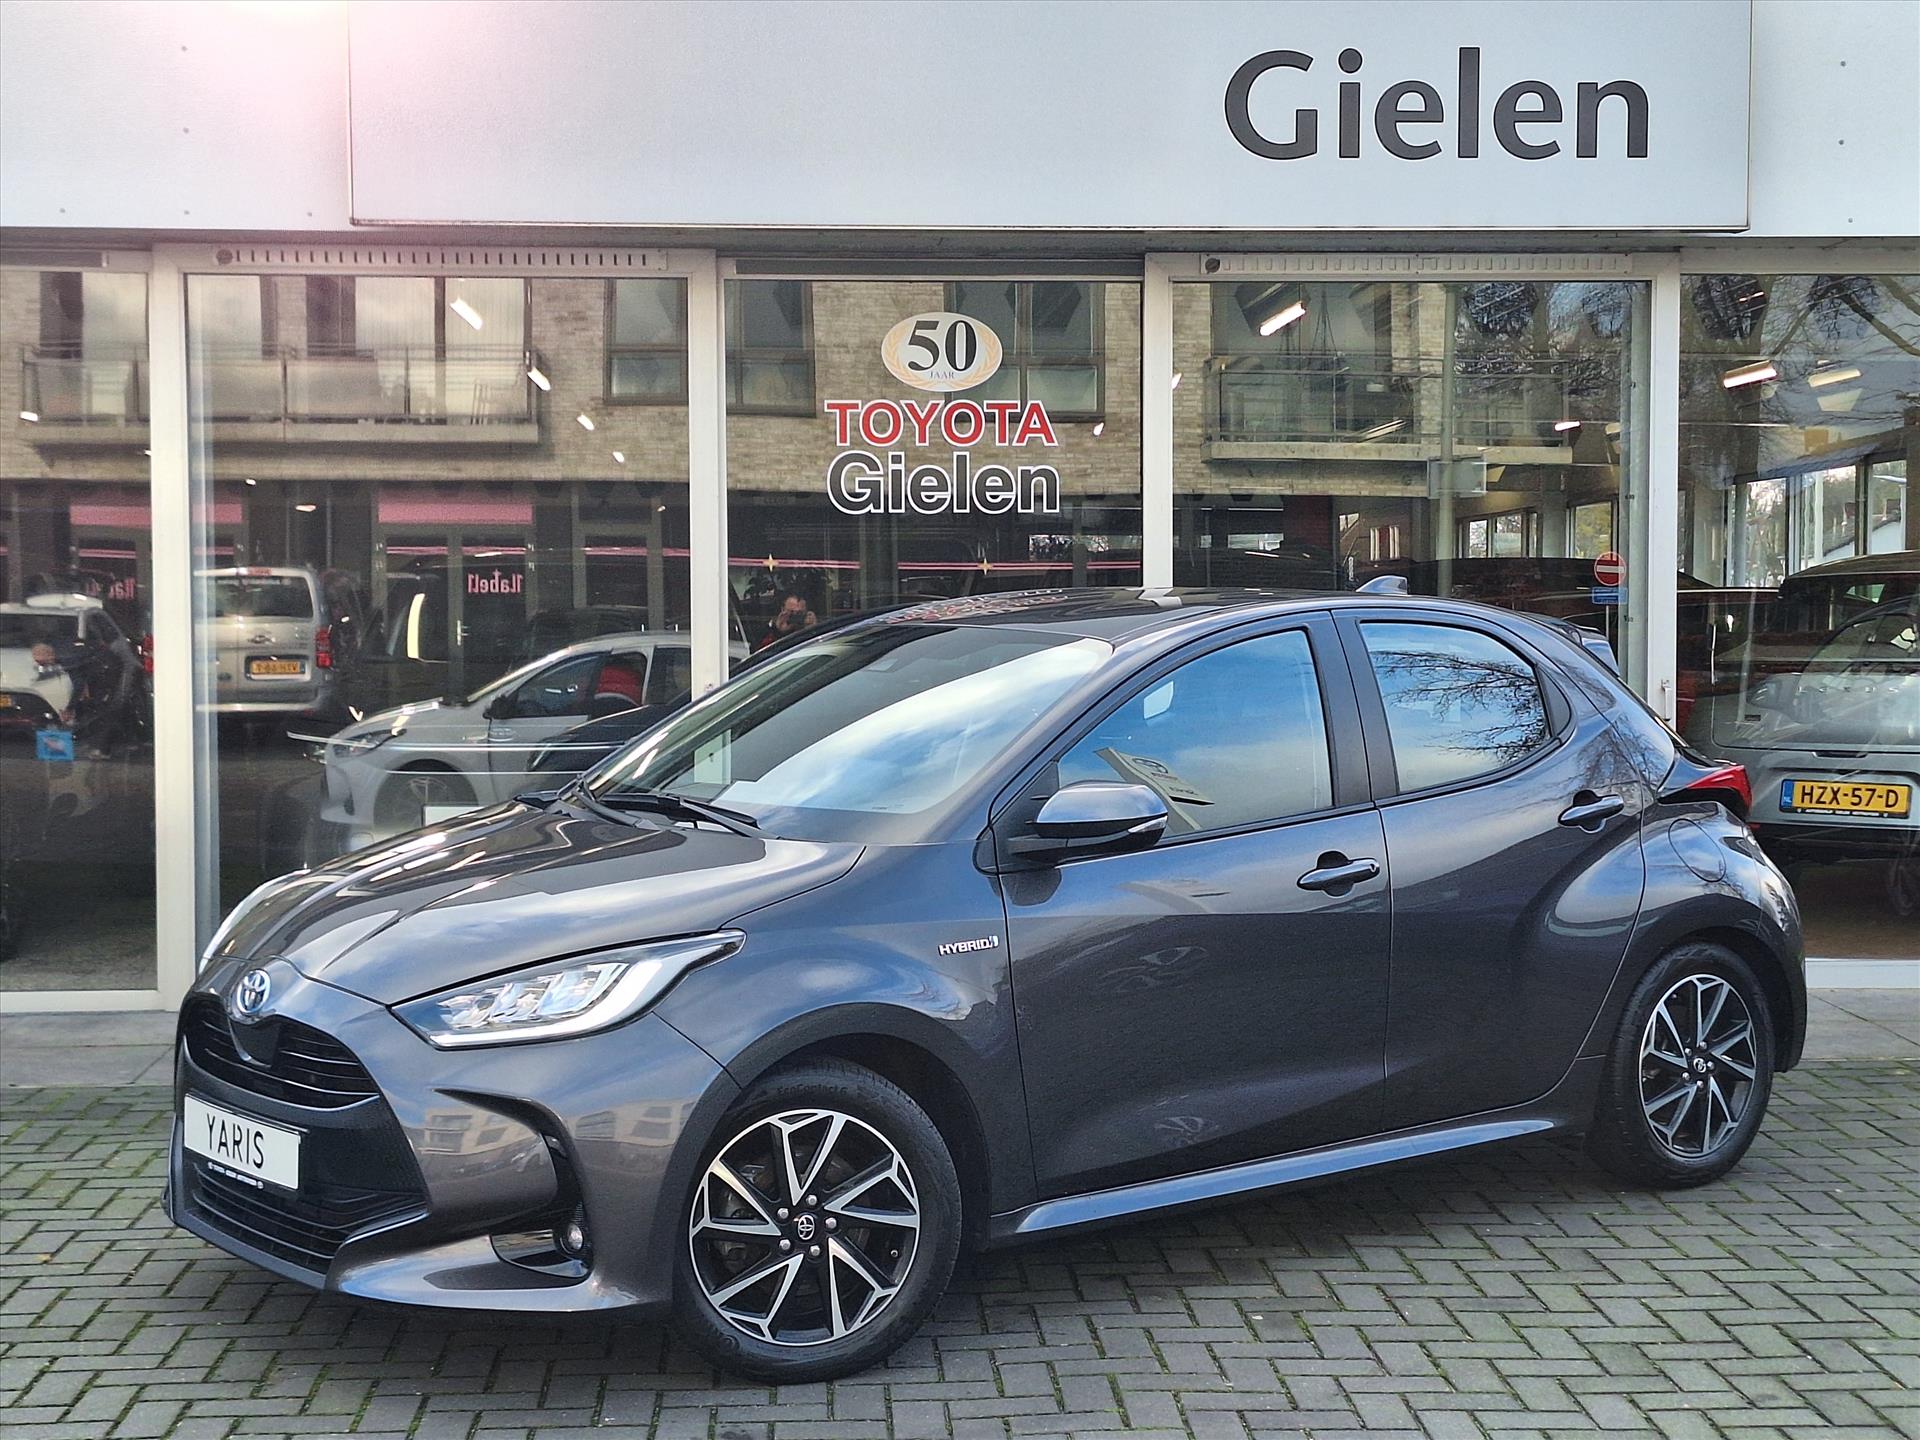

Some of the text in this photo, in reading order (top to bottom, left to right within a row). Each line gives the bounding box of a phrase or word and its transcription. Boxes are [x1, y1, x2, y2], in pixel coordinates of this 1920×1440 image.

[1224, 46, 1649, 160] Gielen
[907, 320, 977, 372] 50
[930, 371, 955, 380] JAAR
[825, 399, 1059, 447] TOYOTA
[827, 450, 1060, 514] Gielen
[1800, 785, 1899, 808] HZX-57-D
[939, 937, 993, 956] HYBRID
[206, 1113, 264, 1169] YARIS
